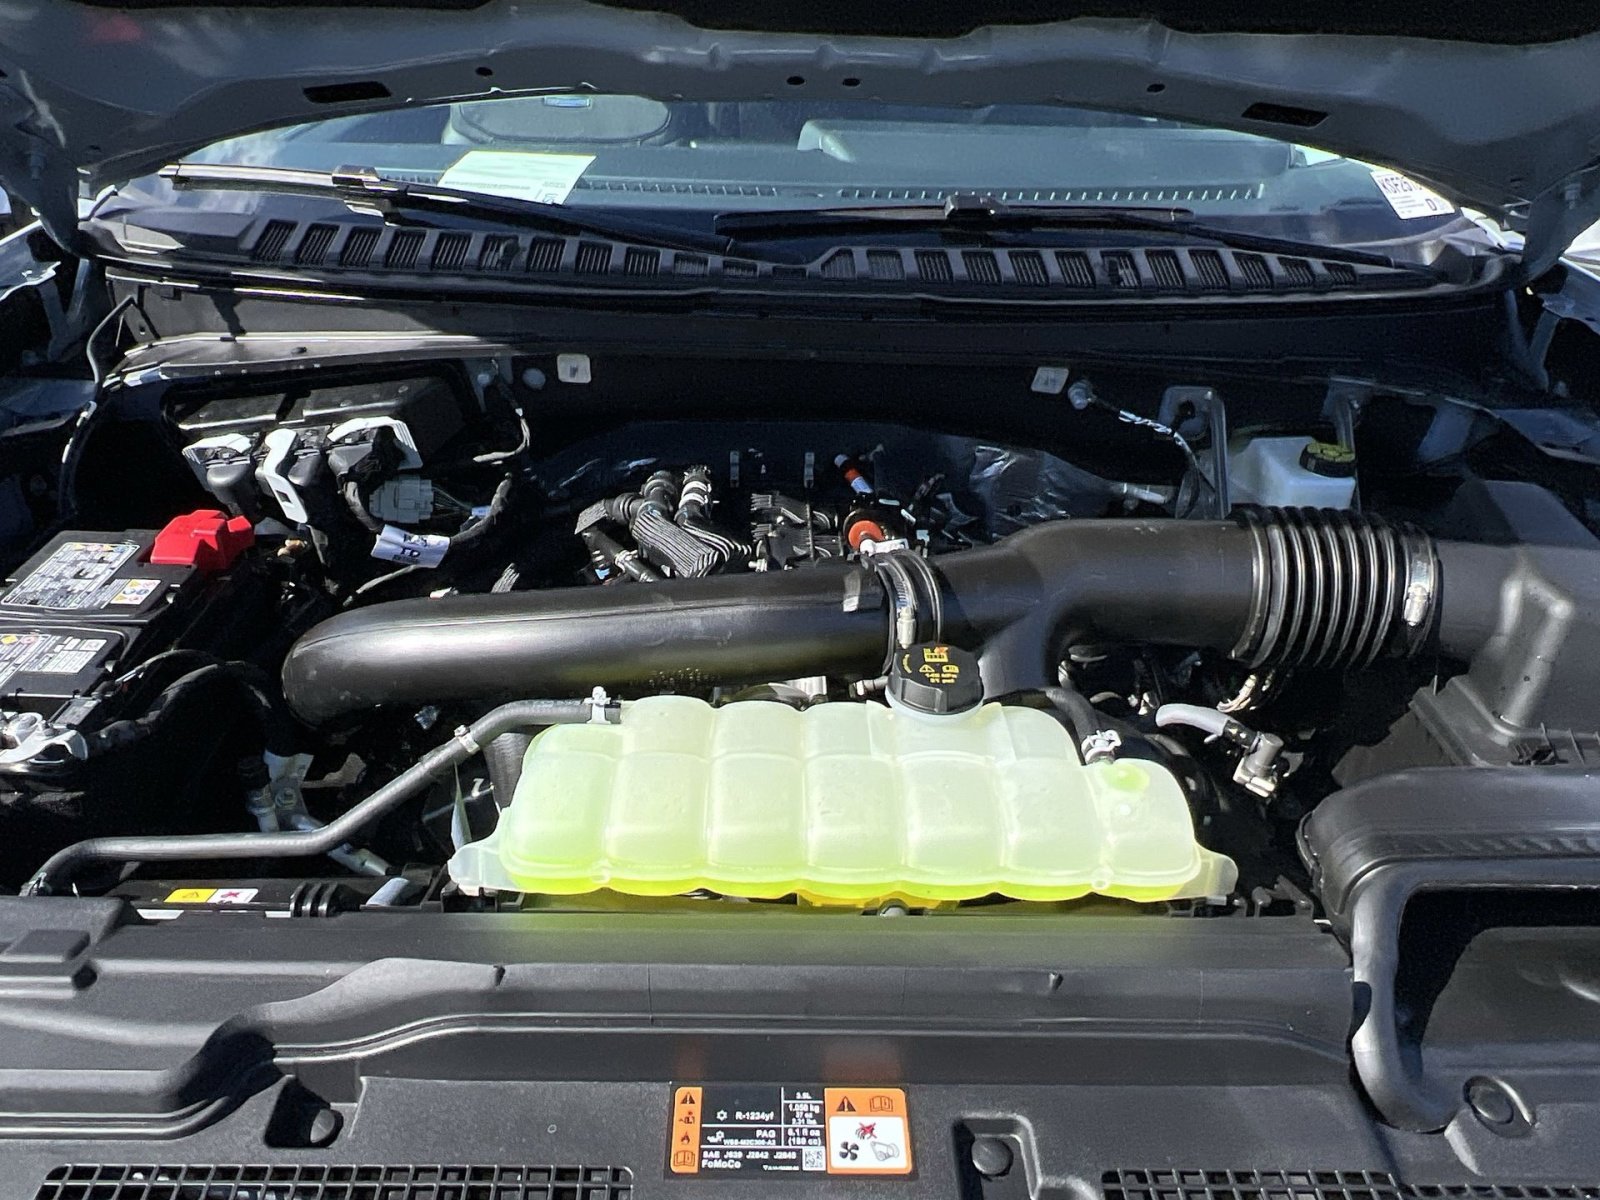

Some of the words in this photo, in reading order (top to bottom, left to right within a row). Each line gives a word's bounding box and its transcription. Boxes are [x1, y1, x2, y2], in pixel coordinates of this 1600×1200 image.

[810, 1104, 820, 1113] kg
[735, 1111, 774, 1121] R-1234yf
[756, 1129, 776, 1138] PAG
[702, 1151, 721, 1159] SAE
[723, 1151, 743, 1159] J639
[701, 1159, 742, 1168] FoMoCo
